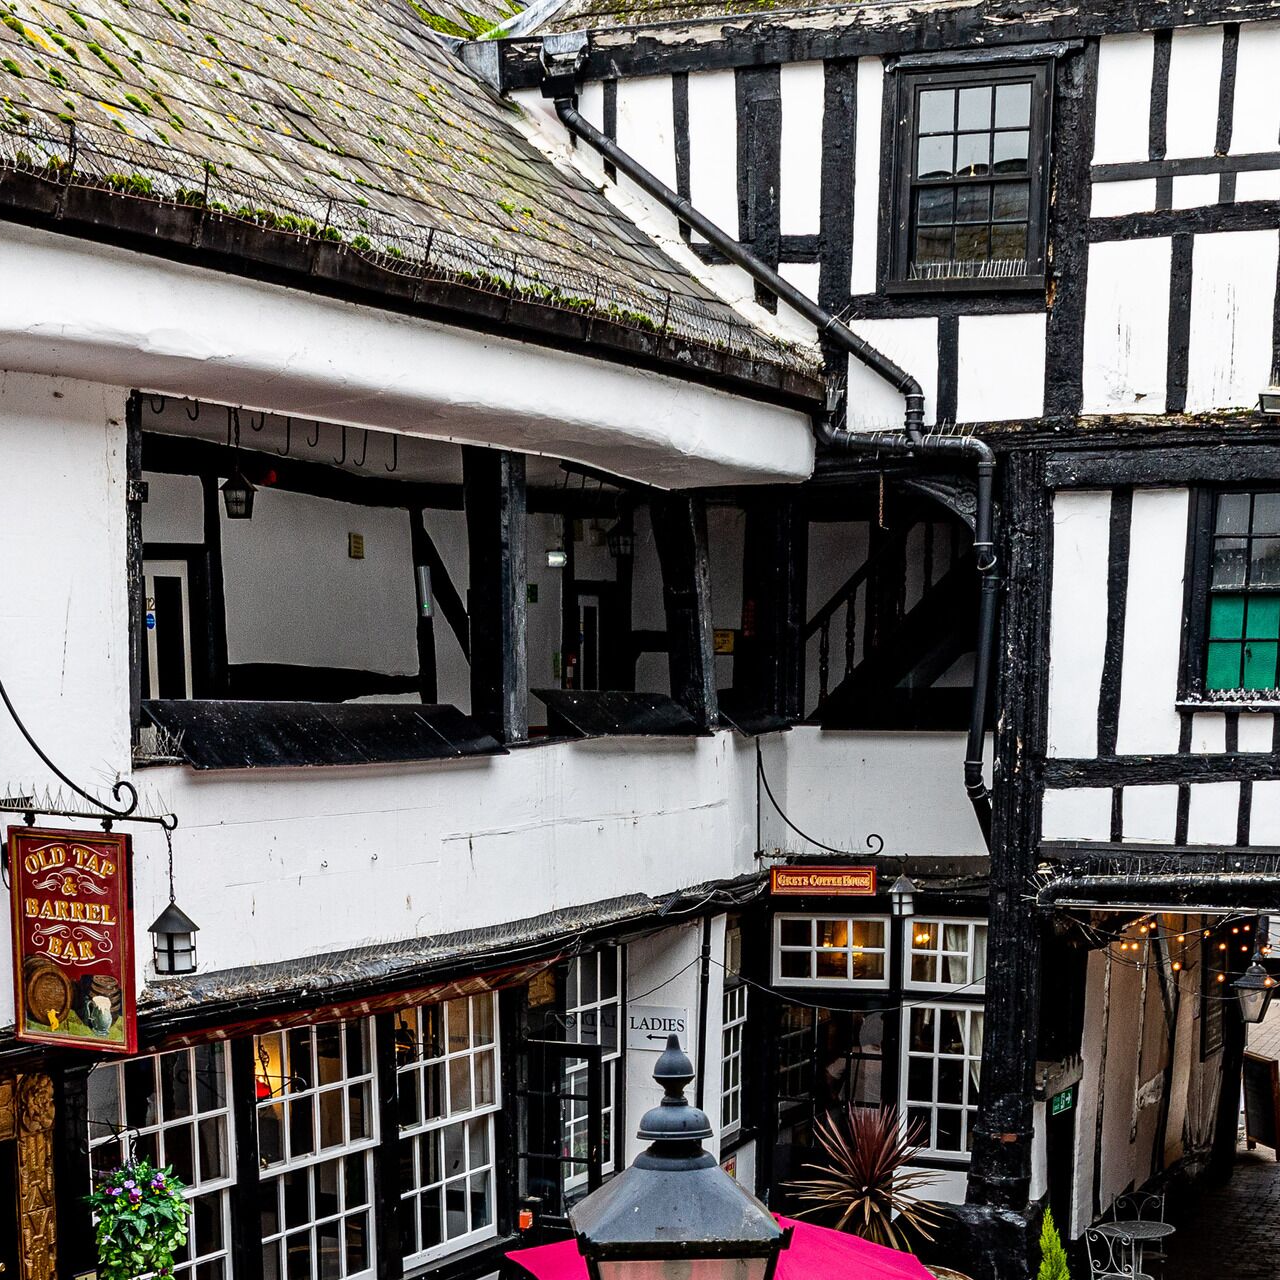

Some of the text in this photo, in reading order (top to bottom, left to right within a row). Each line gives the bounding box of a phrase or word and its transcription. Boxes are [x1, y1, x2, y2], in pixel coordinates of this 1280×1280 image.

[24, 847, 116, 879] OLD TAP
[61, 876, 78, 896] &
[25, 898, 116, 925] BARREL
[48, 935, 96, 961] BAR
[630, 1016, 685, 1032] LADIES
